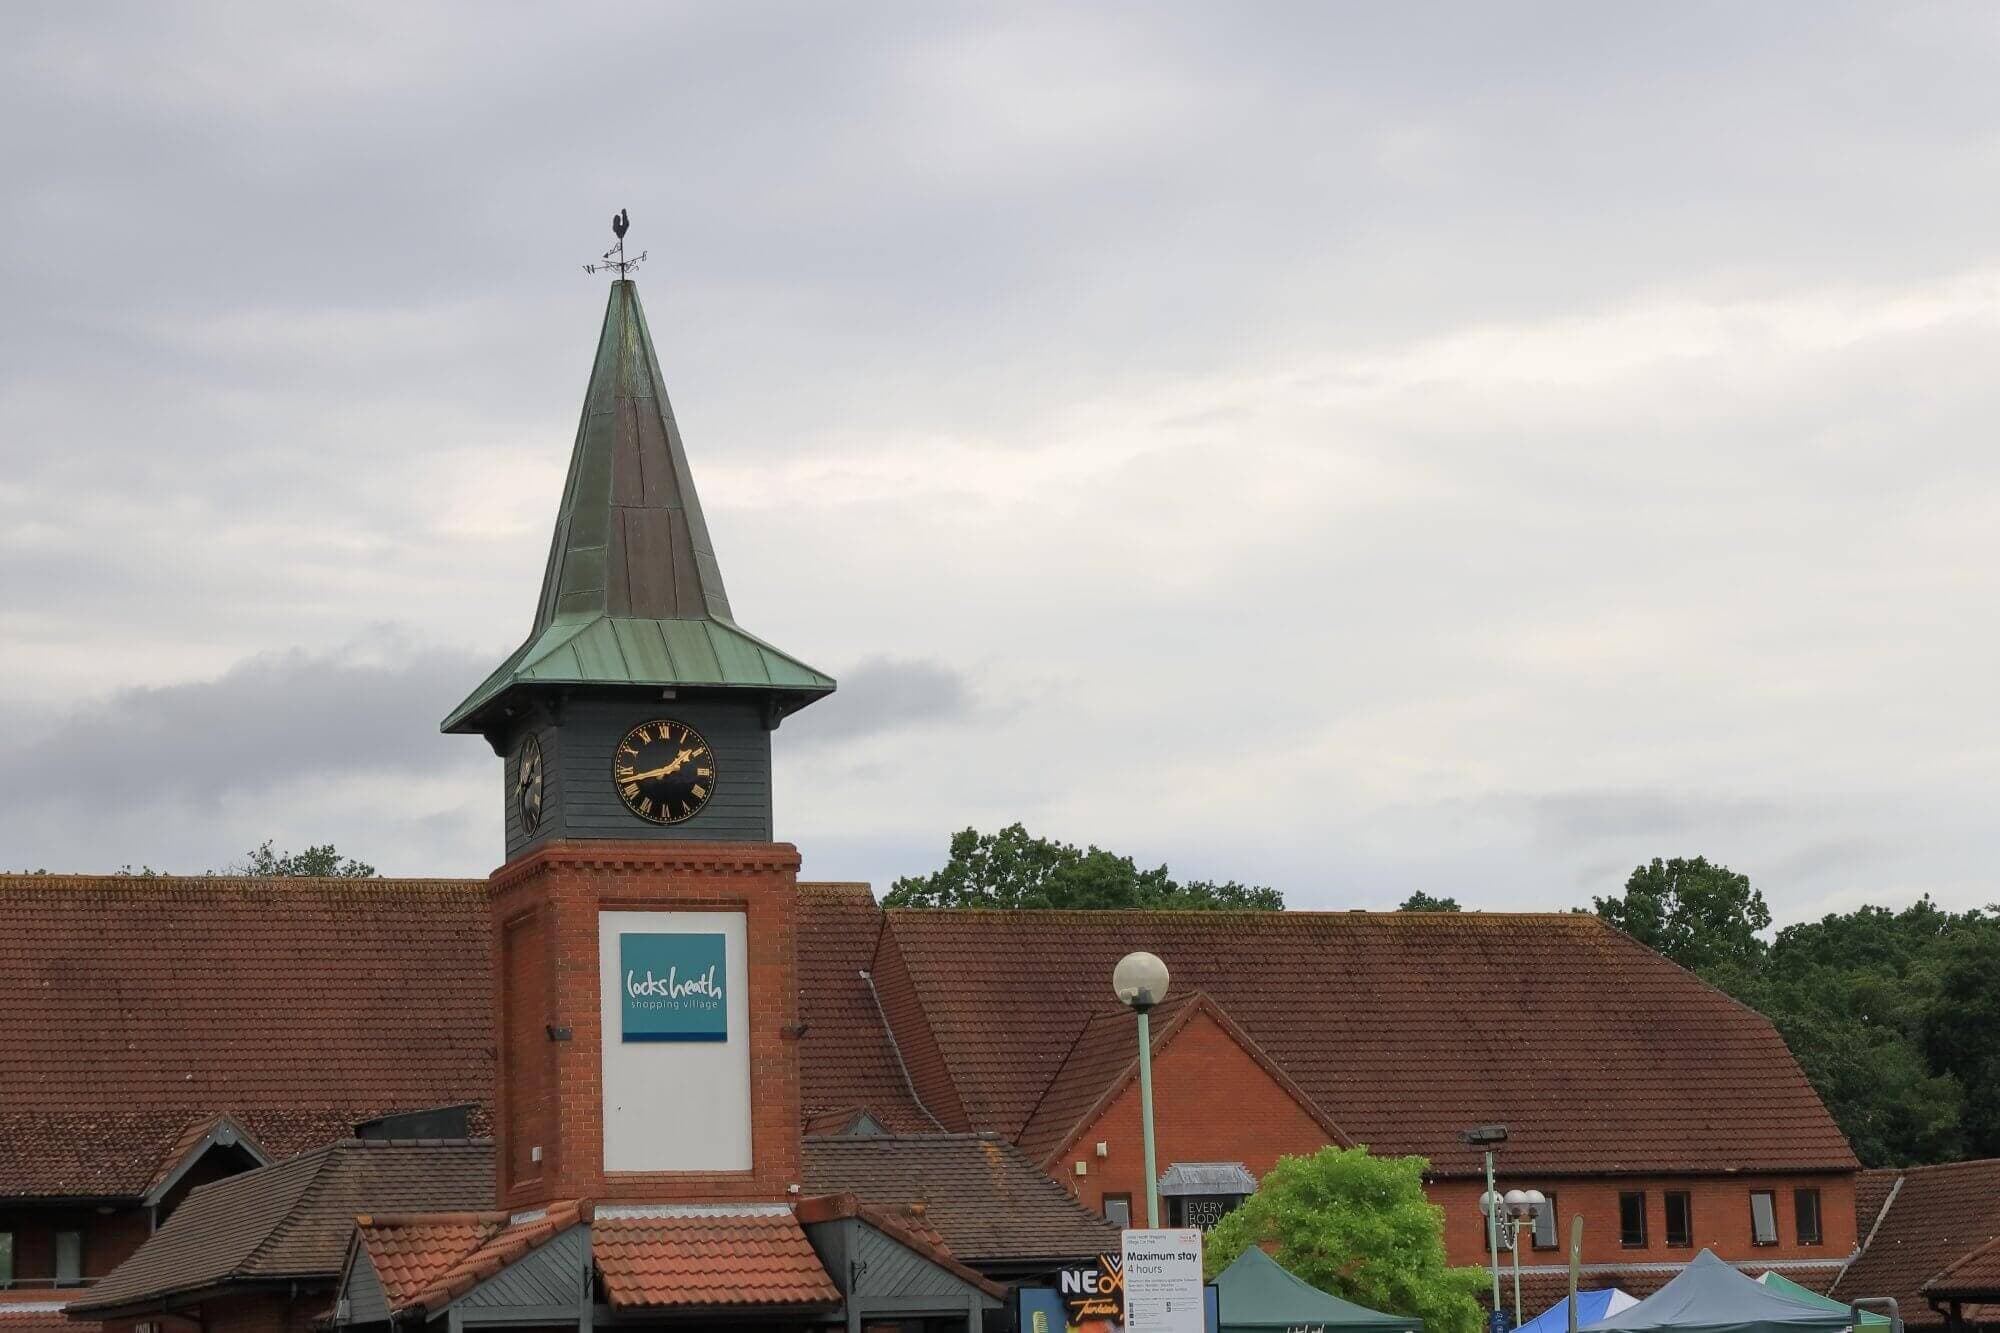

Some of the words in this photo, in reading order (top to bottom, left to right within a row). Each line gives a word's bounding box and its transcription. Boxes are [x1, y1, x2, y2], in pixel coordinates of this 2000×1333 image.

[639, 730, 652, 744] XI
[659, 726, 670, 739] XII
[680, 731, 687, 744] I
[622, 745, 639, 757] X
[697, 768, 710, 776] III
[641, 798, 653, 813] VII
[662, 804, 671, 817] VI
[682, 800, 690, 812] V
[631, 1000, 679, 1010] shopping
[683, 1000, 718, 1010] village
[1188, 1202, 1224, 1213] EVERY
[1189, 1213, 1222, 1224] BODY
[1128, 1251, 1175, 1261] Maximum
[1177, 1251, 1197, 1263] stay
[1128, 1264, 1134, 1272] 4
[1136, 1264, 1163, 1274] hours
